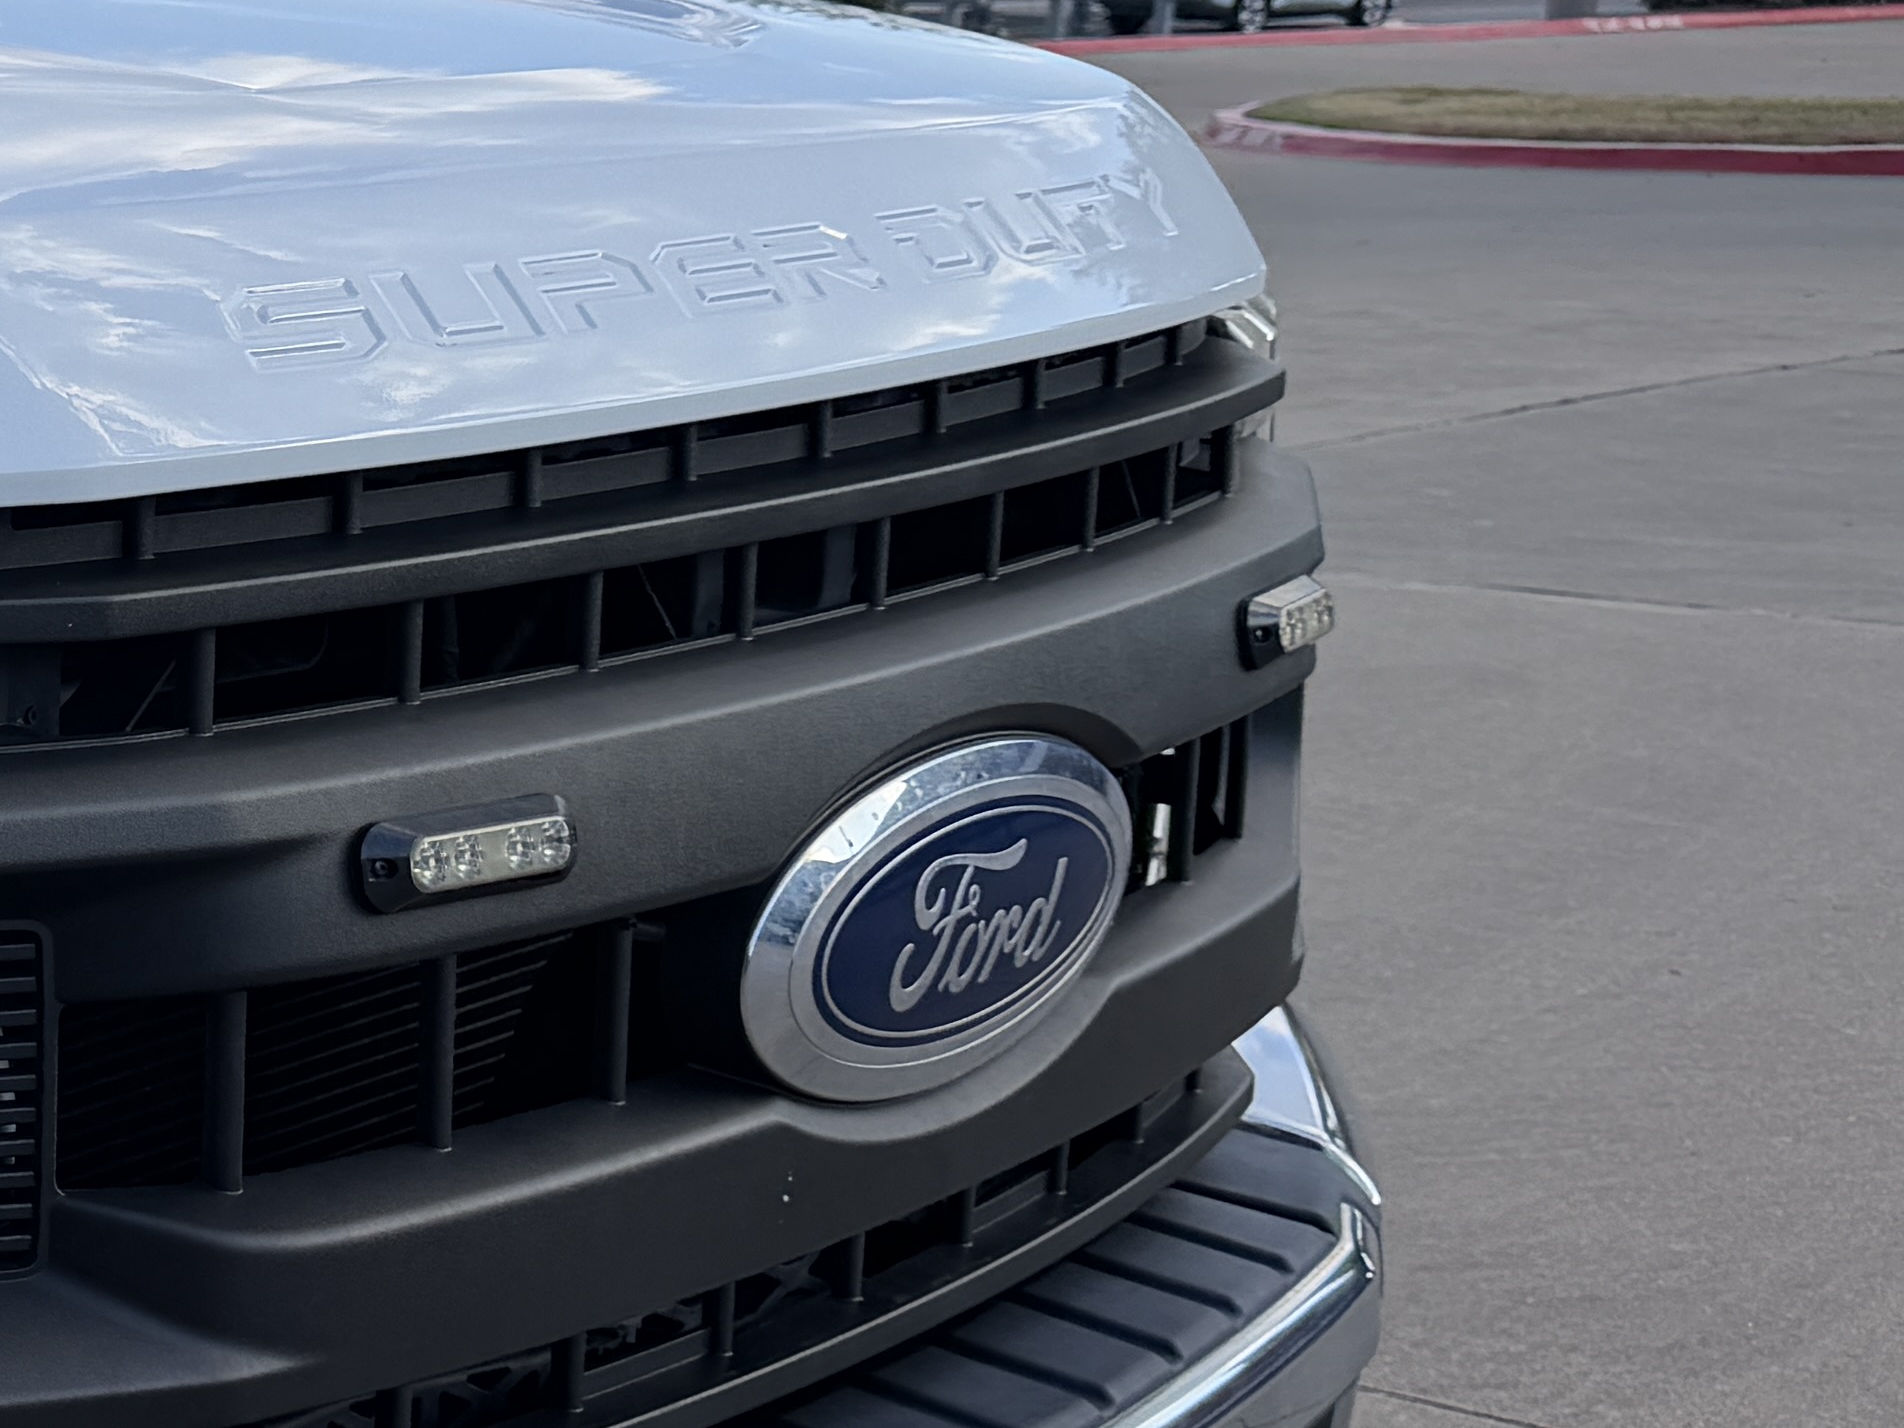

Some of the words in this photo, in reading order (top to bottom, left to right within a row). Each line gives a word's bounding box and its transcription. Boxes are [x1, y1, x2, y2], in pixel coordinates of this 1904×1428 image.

[218, 221, 888, 372] SUPER
[874, 164, 1184, 284] DUTY
[886, 836, 1069, 1014] Ford
